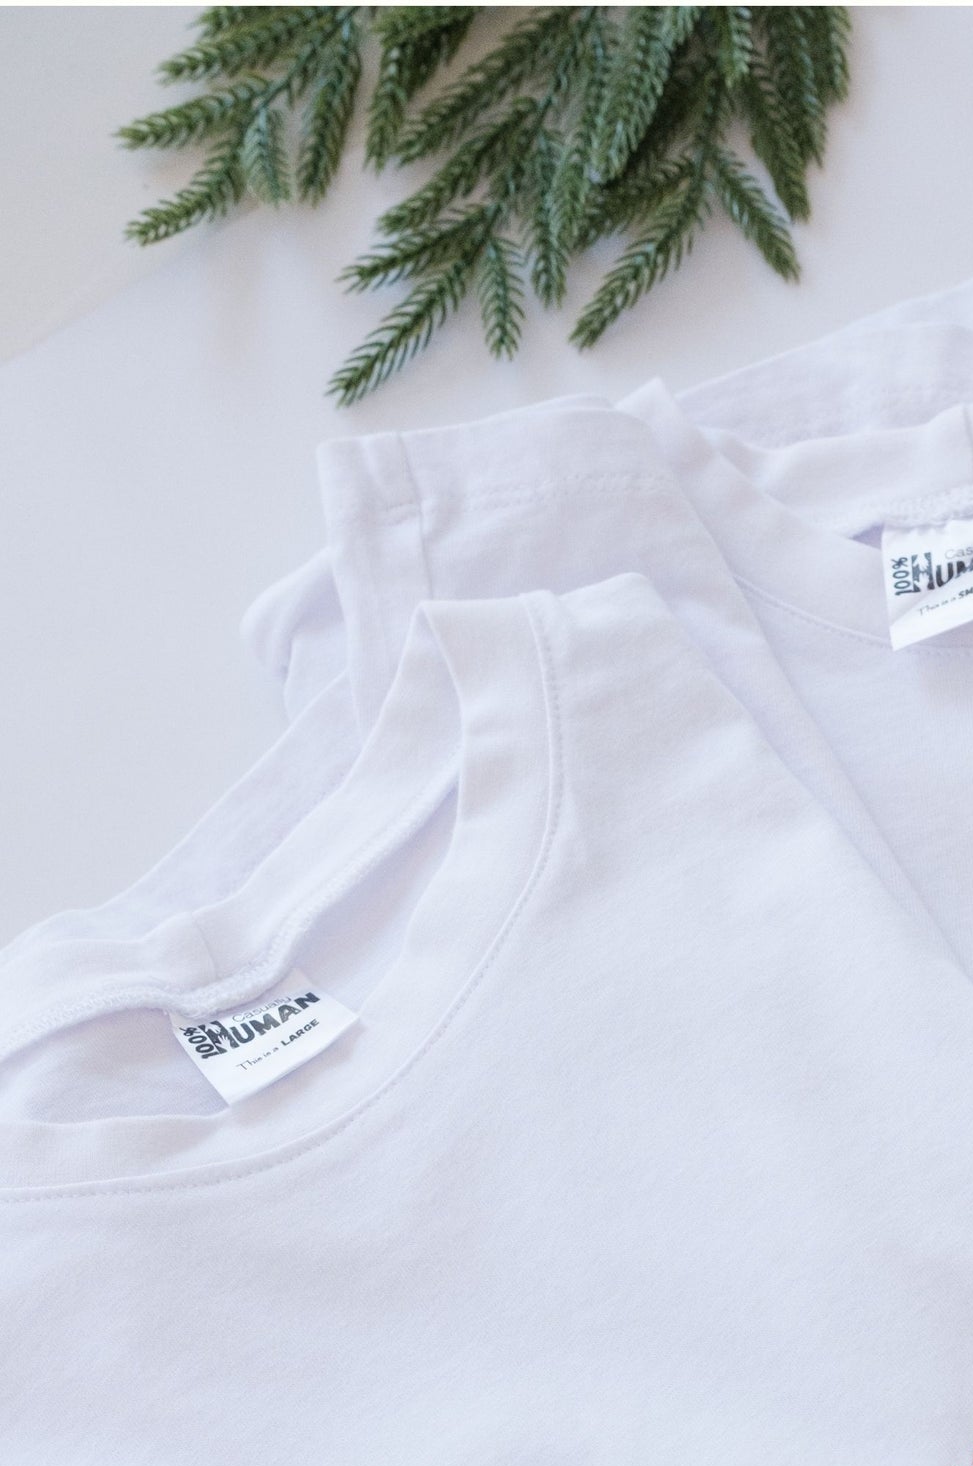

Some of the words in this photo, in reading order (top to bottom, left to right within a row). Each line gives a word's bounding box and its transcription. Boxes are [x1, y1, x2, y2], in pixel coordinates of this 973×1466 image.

[891, 556, 913, 596] 100%
[198, 992, 321, 1056] HUMAN
[232, 996, 292, 1023] Casually
[179, 1026, 220, 1060] 100%
[236, 1056, 263, 1071] This
[281, 1018, 320, 1047] LARGE
